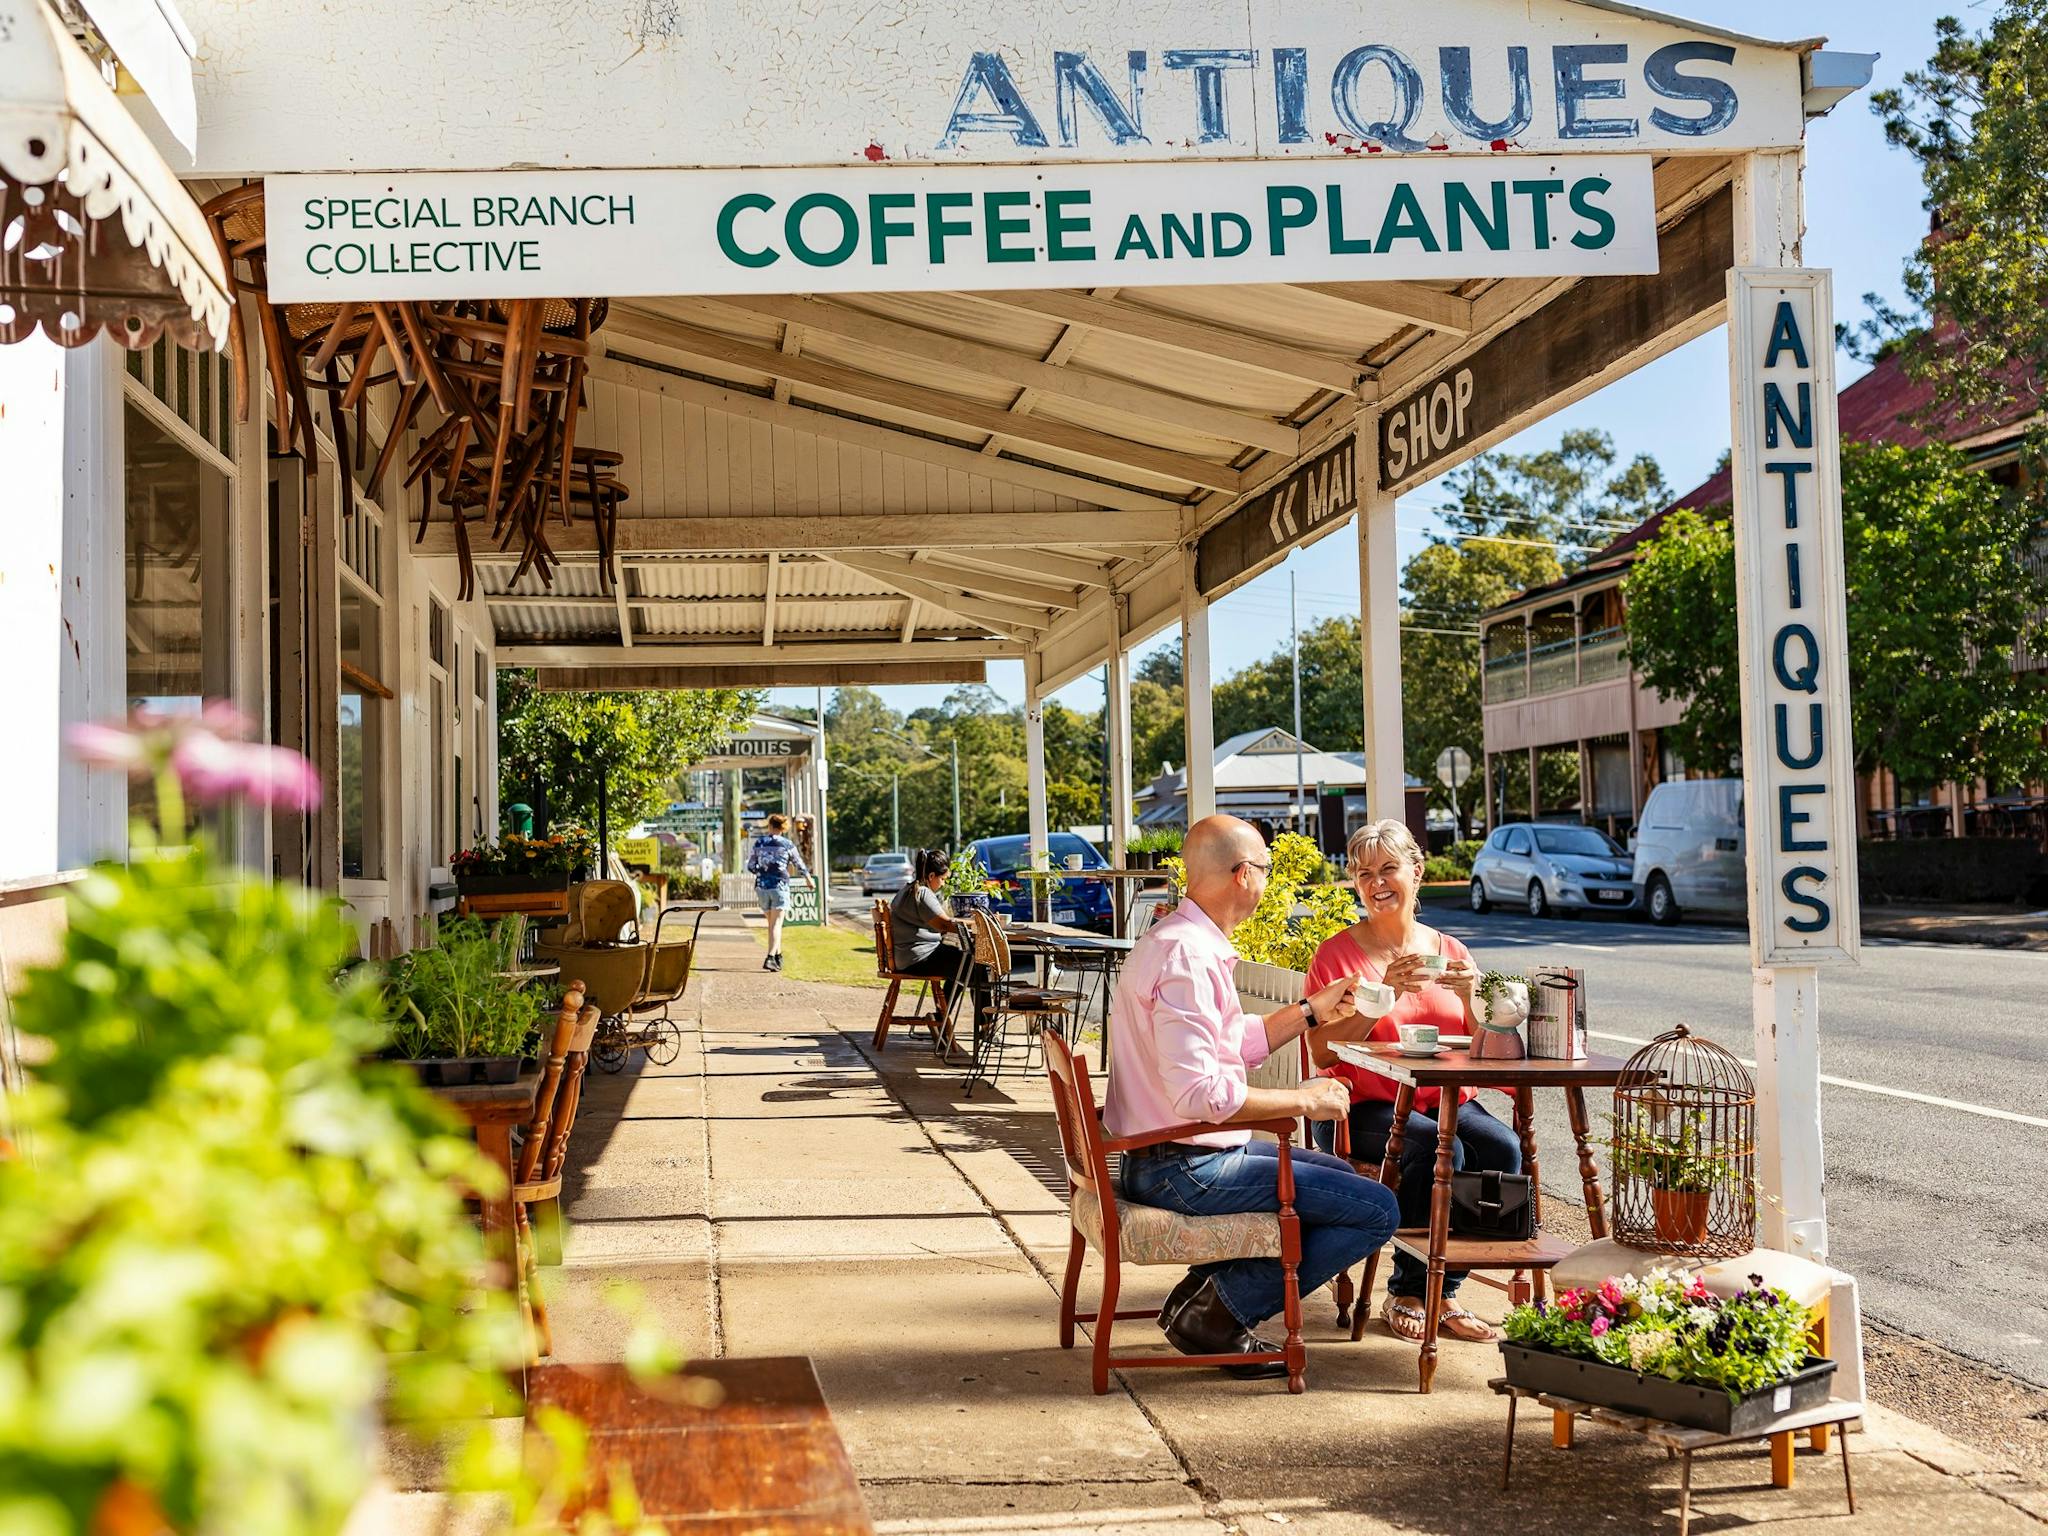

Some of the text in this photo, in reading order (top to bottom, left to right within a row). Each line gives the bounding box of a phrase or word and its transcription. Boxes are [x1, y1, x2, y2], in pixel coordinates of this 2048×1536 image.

[938, 41, 1739, 152] ANTIQUES
[304, 194, 635, 230] SPECIAL BRANCH
[716, 176, 1617, 269] COFFEE AND PLANTS
[305, 240, 541, 275] COLLECTIVE
[1307, 367, 1474, 527] MAI SHOP
[1763, 301, 1831, 934] ANTIQUES
[705, 740, 792, 757] NTIQUES
[785, 907, 819, 922] OPEN
